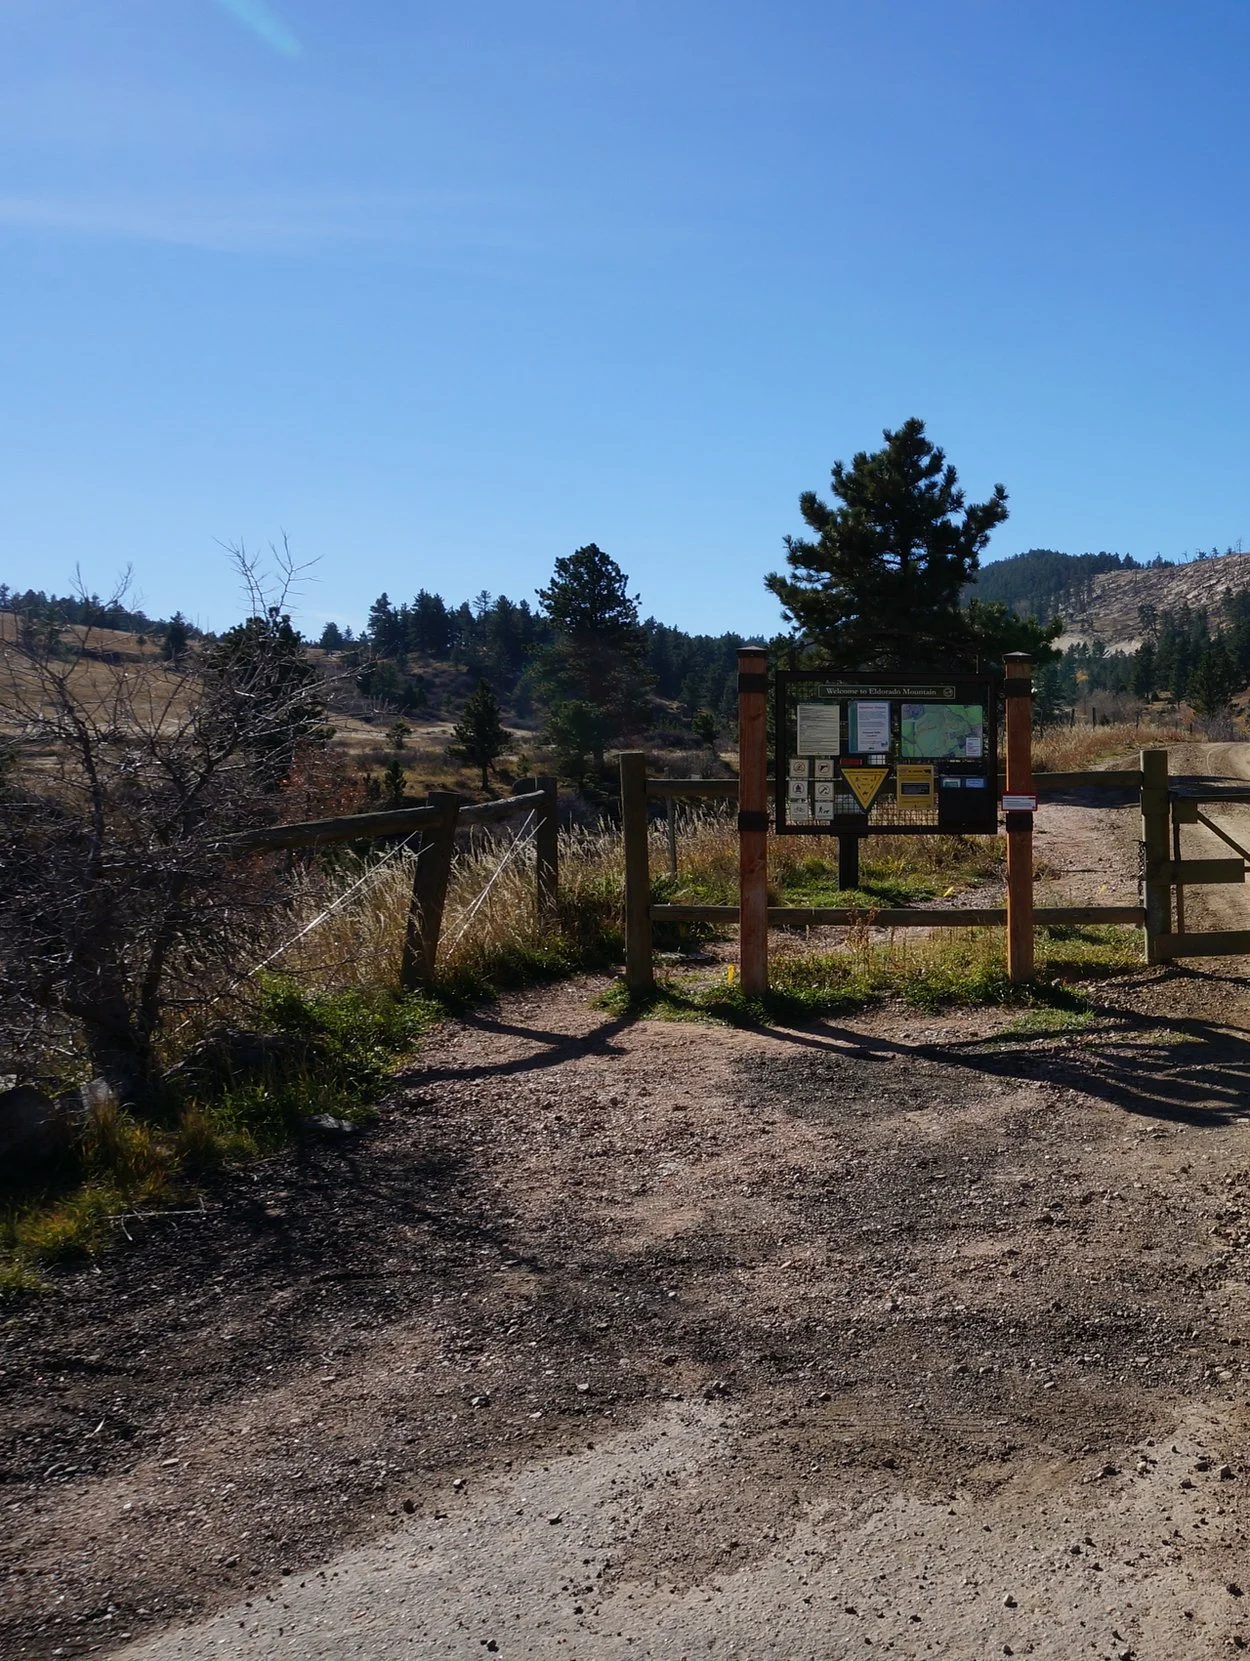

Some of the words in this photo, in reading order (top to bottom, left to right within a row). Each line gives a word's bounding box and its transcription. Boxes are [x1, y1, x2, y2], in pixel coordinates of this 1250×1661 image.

[825, 687, 858, 695] Welcome
[869, 687, 901, 695] Eldorado
[902, 688, 937, 696] Mountain
